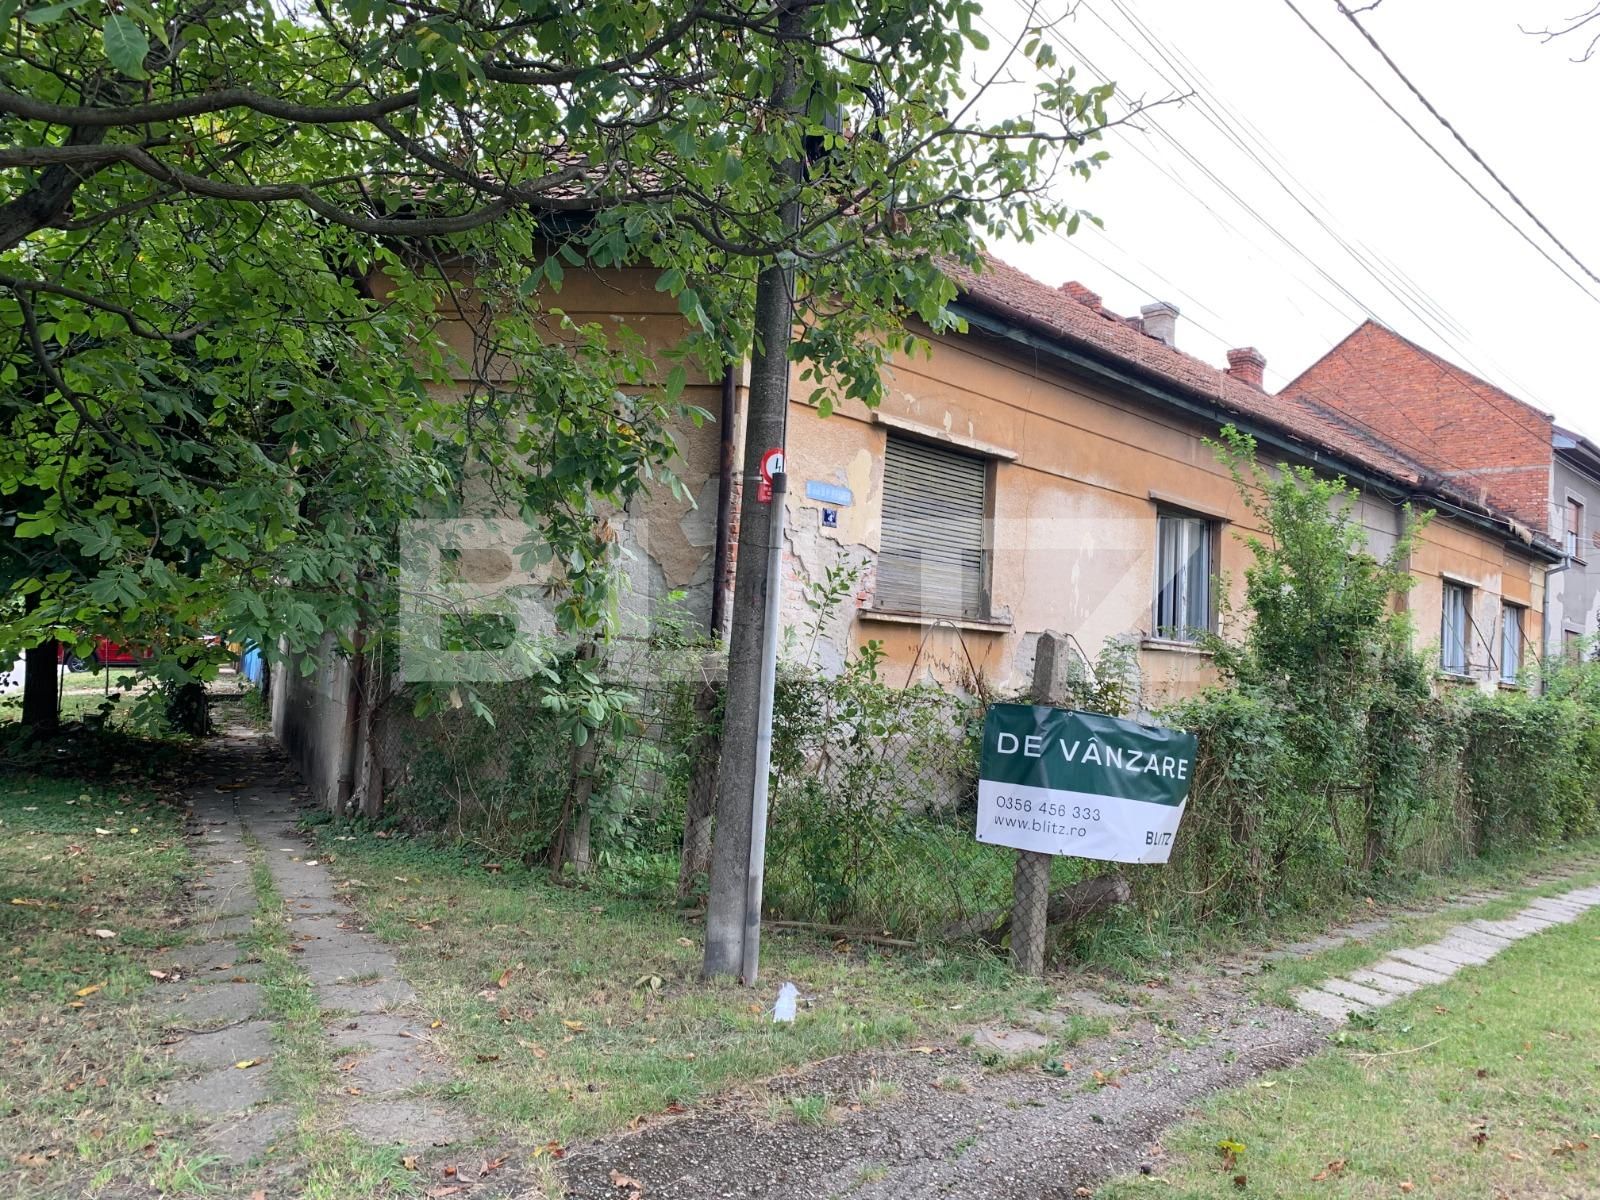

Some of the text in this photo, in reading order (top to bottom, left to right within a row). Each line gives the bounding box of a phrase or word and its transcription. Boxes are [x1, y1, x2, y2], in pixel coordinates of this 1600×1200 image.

[997, 732, 1189, 780] DE VÂNZARE
[996, 795, 1101, 822] 0356 456 333
[994, 814, 1087, 837] www.blitz.ro
[1145, 831, 1172, 846] BLITZ
